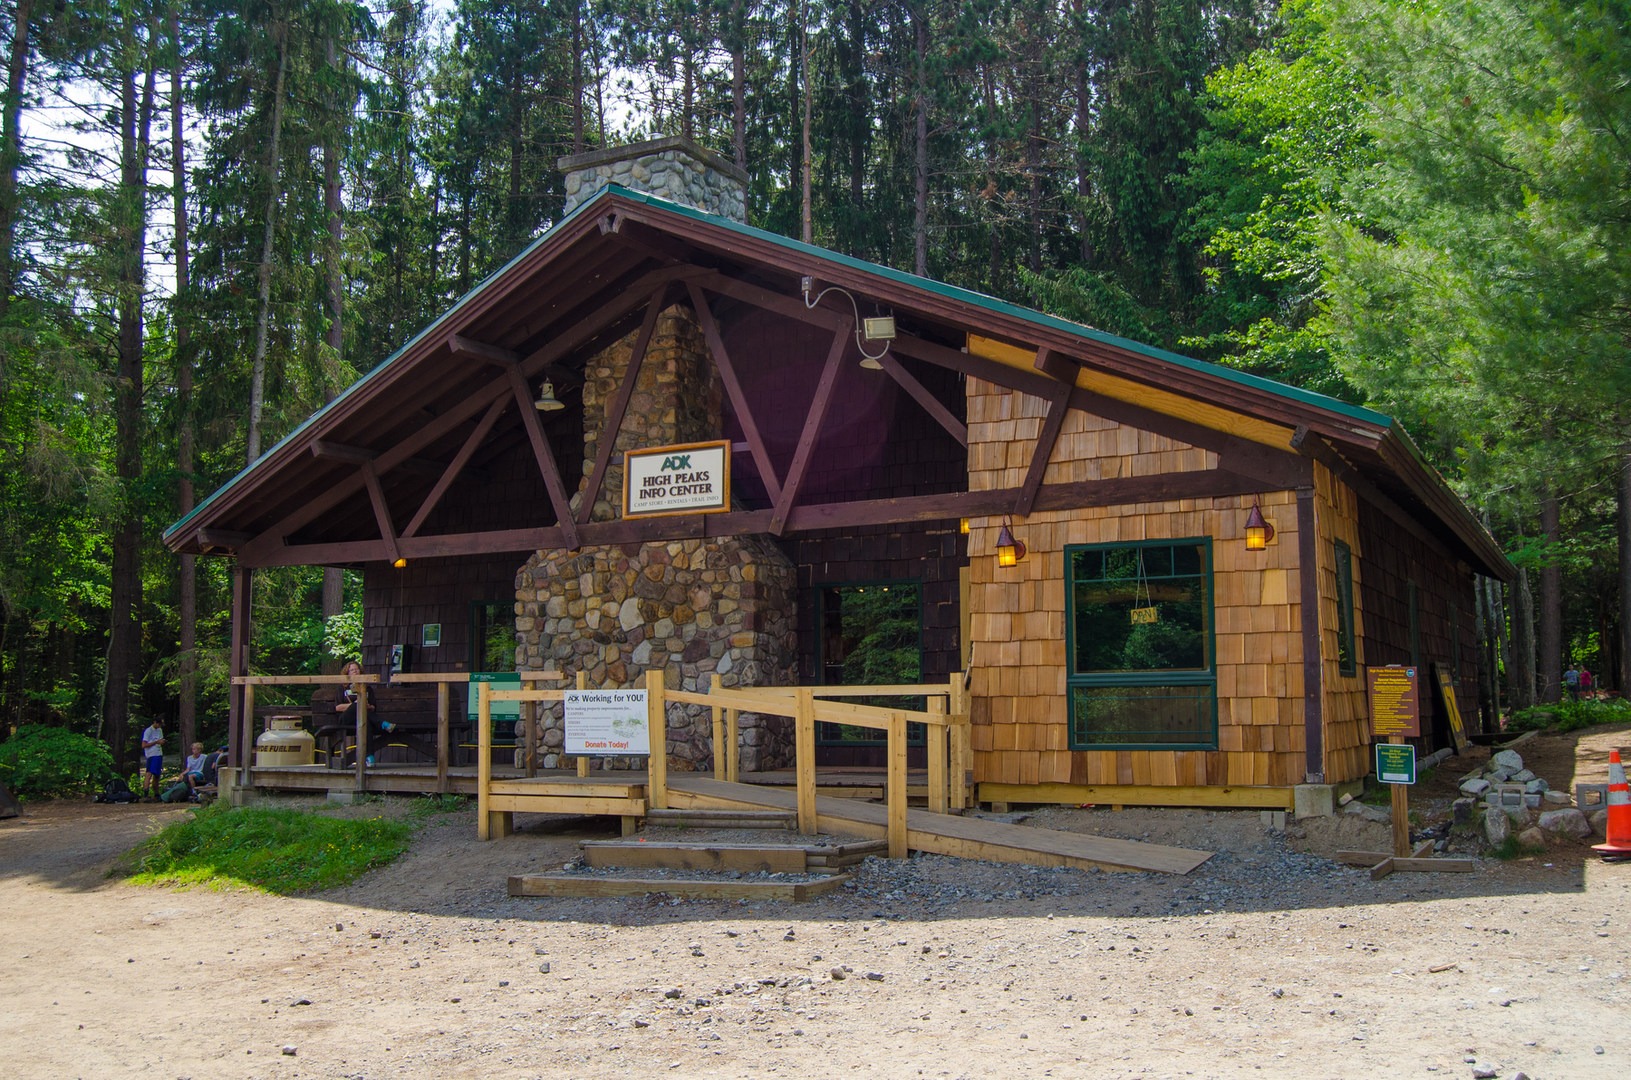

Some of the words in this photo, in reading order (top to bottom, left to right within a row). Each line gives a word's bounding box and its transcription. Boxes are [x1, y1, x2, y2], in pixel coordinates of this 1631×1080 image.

[660, 454, 692, 472] ADK
[643, 475, 672, 487] HIGH
[675, 471, 710, 484] PEAKS
[639, 487, 666, 499] INFO
[669, 483, 713, 497] CENTER
[1133, 608, 1151, 622] OPEN
[581, 694, 612, 703] Working
[626, 694, 644, 702] YOU!
[585, 741, 607, 749] Donate
[608, 741, 629, 749] Today!
